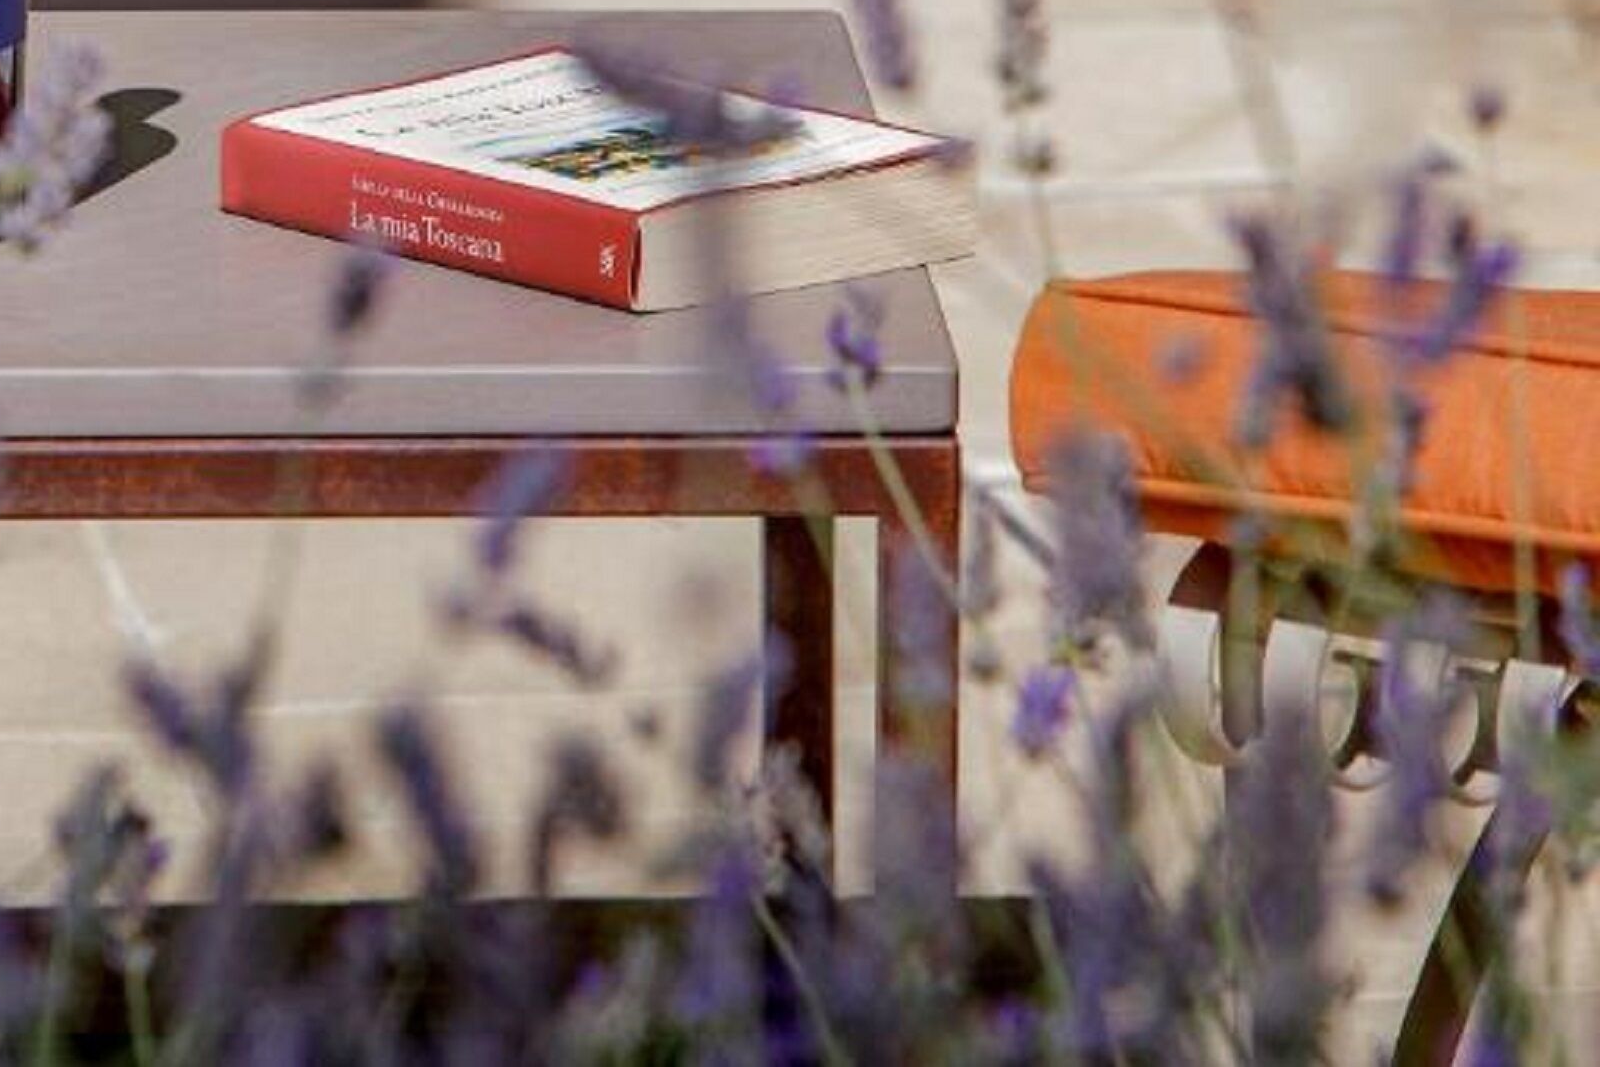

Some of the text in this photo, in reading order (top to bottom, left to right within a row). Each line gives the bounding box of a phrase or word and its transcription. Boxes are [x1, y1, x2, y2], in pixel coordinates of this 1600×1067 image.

[350, 201, 504, 263] La mia Toscana
